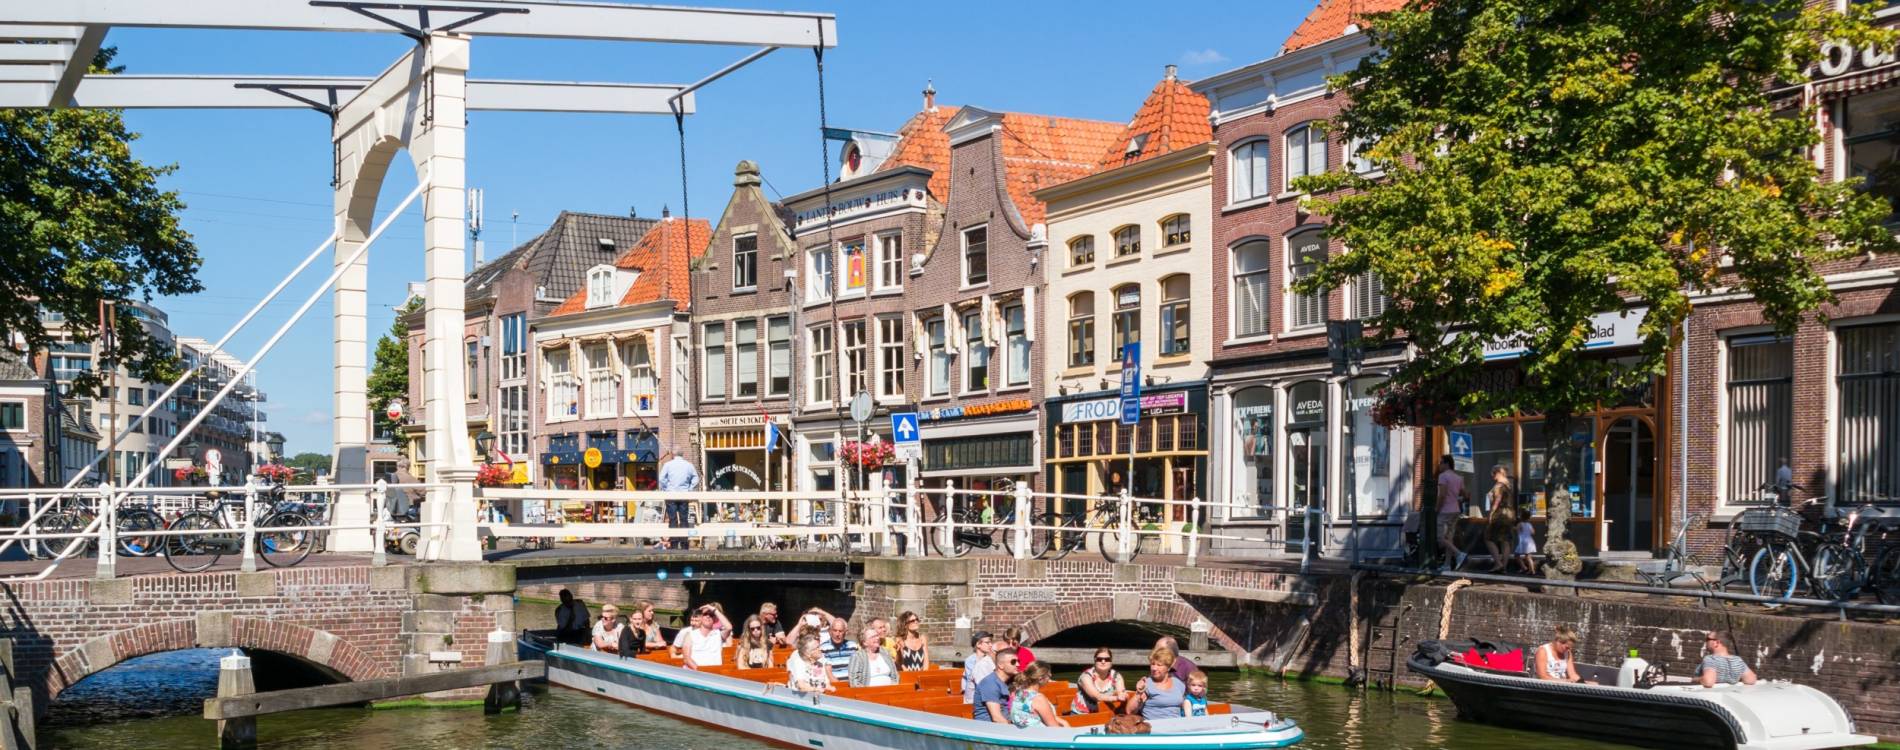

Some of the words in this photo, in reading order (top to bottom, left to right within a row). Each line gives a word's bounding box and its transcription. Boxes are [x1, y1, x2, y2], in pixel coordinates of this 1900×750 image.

[1300, 243, 1320, 252] AVEDA
[1075, 400, 1119, 420] FROD
[1296, 400, 1324, 410] AVEDA
[998, 590, 1054, 600] SCHAPENBRUG
